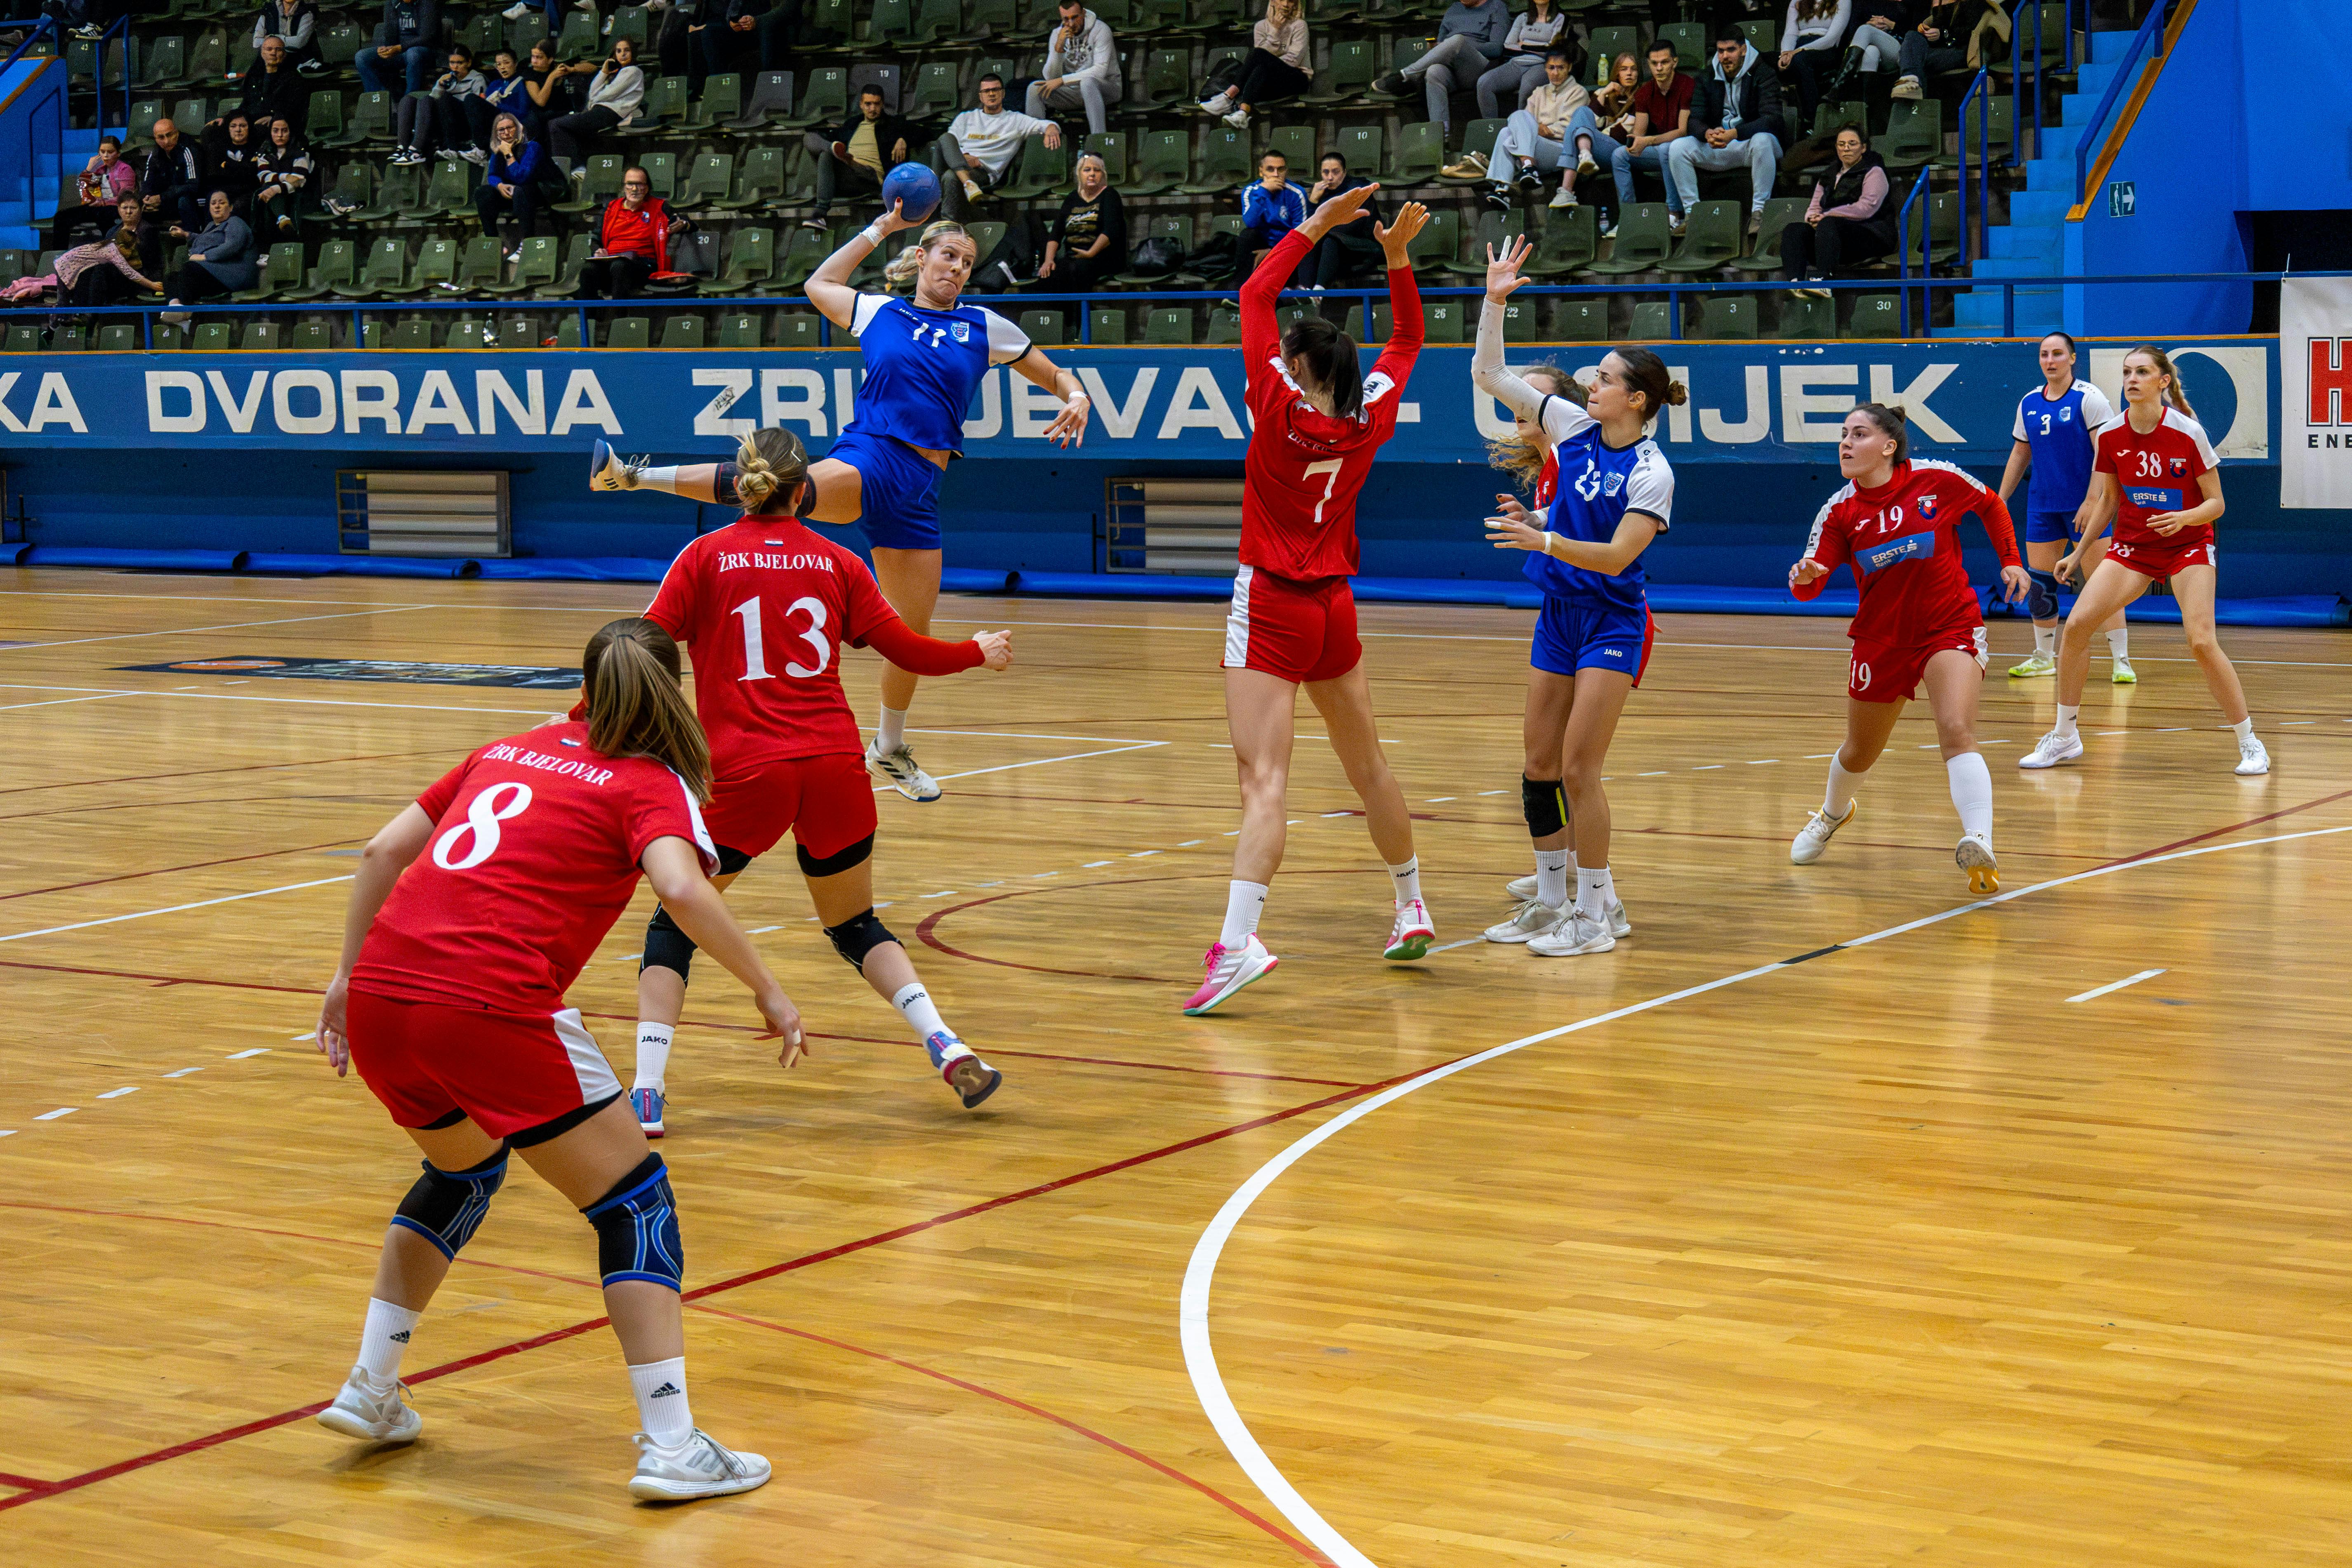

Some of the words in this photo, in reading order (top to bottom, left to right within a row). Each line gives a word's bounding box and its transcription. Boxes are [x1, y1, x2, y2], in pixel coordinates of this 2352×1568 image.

[2043, 9, 2046, 19] 1
[1751, 26, 1757, 34] 5
[1351, 46, 1360, 54] 11
[1911, 106, 1917, 114] 2
[1226, 133, 1235, 141] 12
[1357, 132, 1367, 140] 10
[1938, 199, 1942, 208] 1
[1713, 207, 1719, 215] 4
[1168, 222, 1179, 231] 30
[1232, 220, 1240, 229] 11
[698, 236, 709, 244] 20
[1730, 304, 1737, 313] 3
[1876, 301, 1891, 311] 30
[1434, 308, 1446, 319] 26
[1507, 307, 1518, 318] 22
[1582, 307, 1588, 316] 5
[1102, 316, 1108, 324] 6
[1168, 314, 1176, 323] 11
[145, 369, 624, 435] DVORANA
[692, 367, 1256, 439] ZRIJEVA
[1473, 363, 1968, 443] OIJEK
[2308, 434, 2352, 448] ENE
[2135, 450, 2162, 477] 38
[1302, 457, 1343, 523] 7
[2133, 493, 2157, 501] ERSTE
[1877, 505, 1903, 534] 19
[1871, 545, 1906, 564] ERSTE
[719, 551, 751, 573] ŽRK
[754, 553, 833, 573] BJELOVAR
[731, 596, 831, 681] 13
[1604, 648, 1622, 658] JAKO
[1850, 660, 1871, 691] 19
[518, 751, 613, 786] BJELOVAR
[432, 782, 533, 870] 8
[1396, 868, 1416, 877] JAKO
[902, 992, 926, 1009] JAKO
[641, 1035, 668, 1045] JAKO
[650, 1387, 680, 1398] adidas
